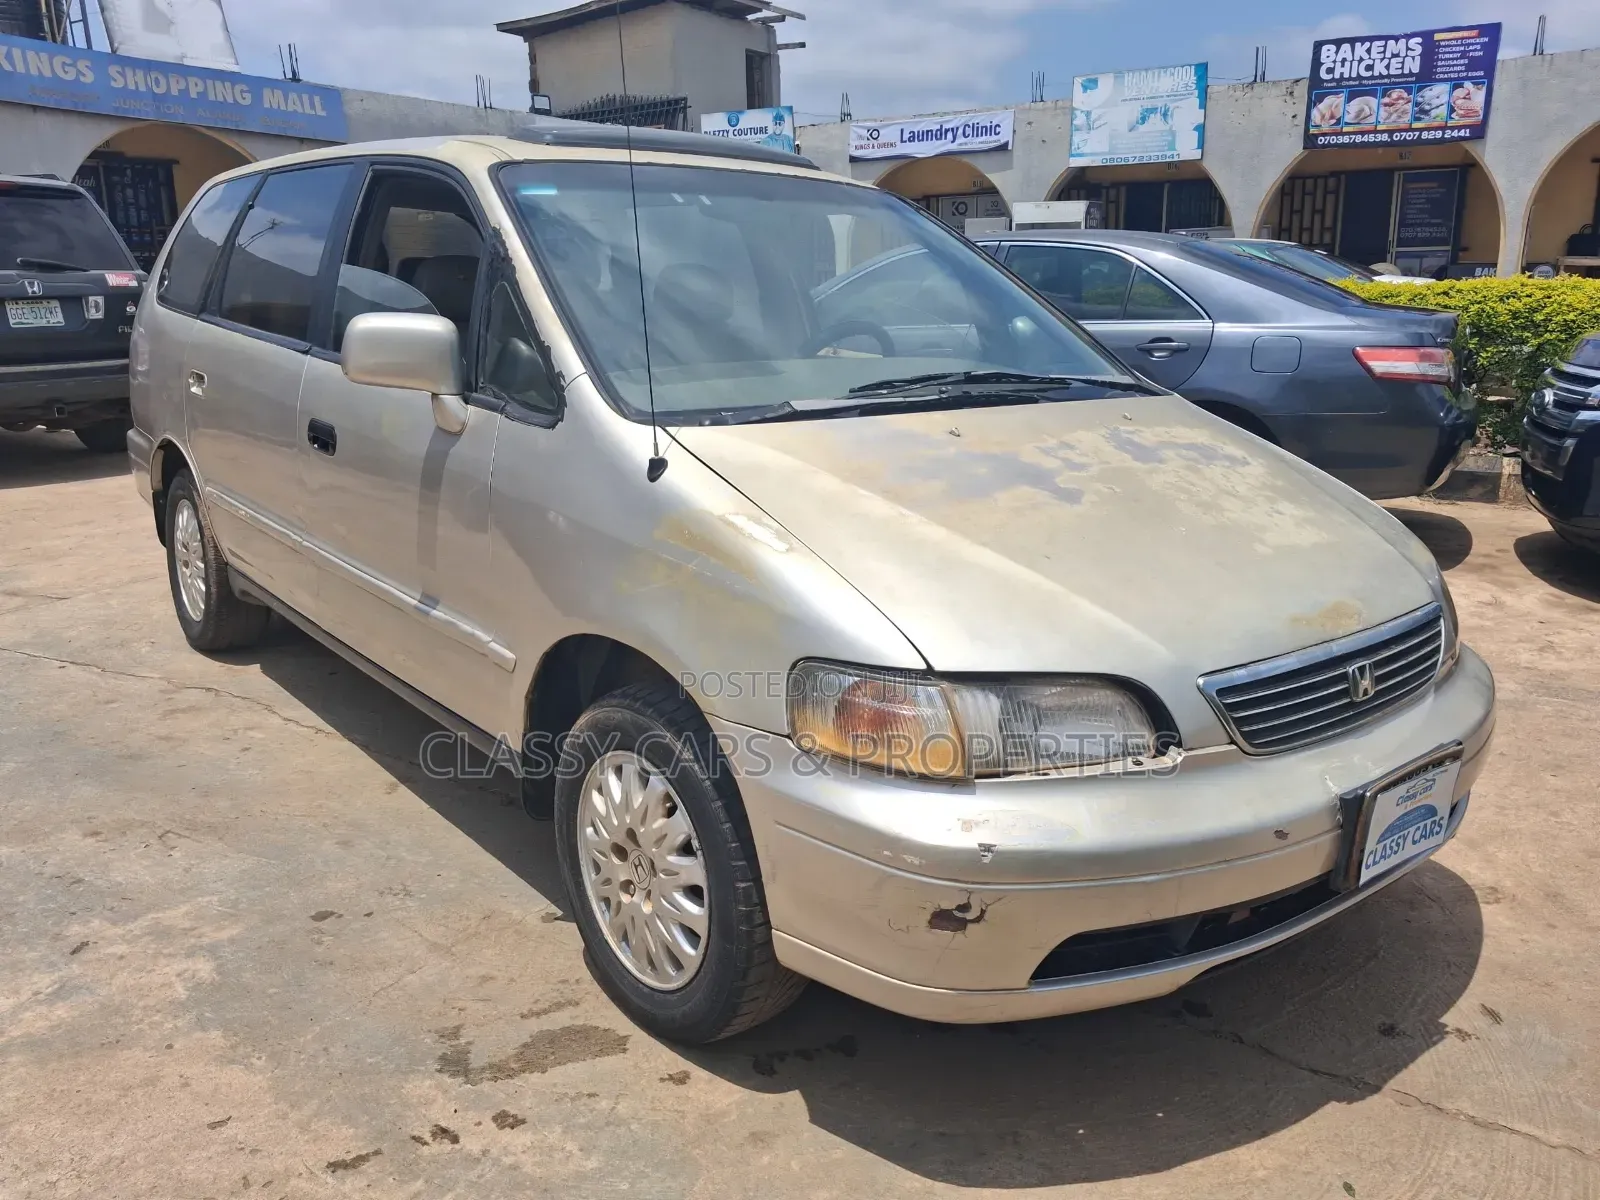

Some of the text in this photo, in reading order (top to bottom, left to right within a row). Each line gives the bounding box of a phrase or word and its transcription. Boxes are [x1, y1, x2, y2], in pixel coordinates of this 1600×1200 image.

[1320, 37, 1423, 63] BAKEMS
[1319, 55, 1421, 80] CHICKEN
[108, 64, 252, 105] SHOPPING
[262, 87, 327, 116] MALL
[112, 98, 184, 115] JUNCTION
[732, 126, 769, 137] COUTURE
[900, 124, 960, 143] Laundry
[962, 121, 1002, 139] Clinic
[1392, 131, 1420, 141] 0707
[1421, 130, 1443, 139] 829
[1443, 128, 1471, 138] 2441
[854, 143, 871, 151] KINGS
[876, 141, 897, 149] QUEENS
[1474, 267, 1497, 277] BAK
[118, 325, 133, 334] PIL
[1365, 830, 1410, 870] CLASSY
[1411, 816, 1444, 846] CARS
